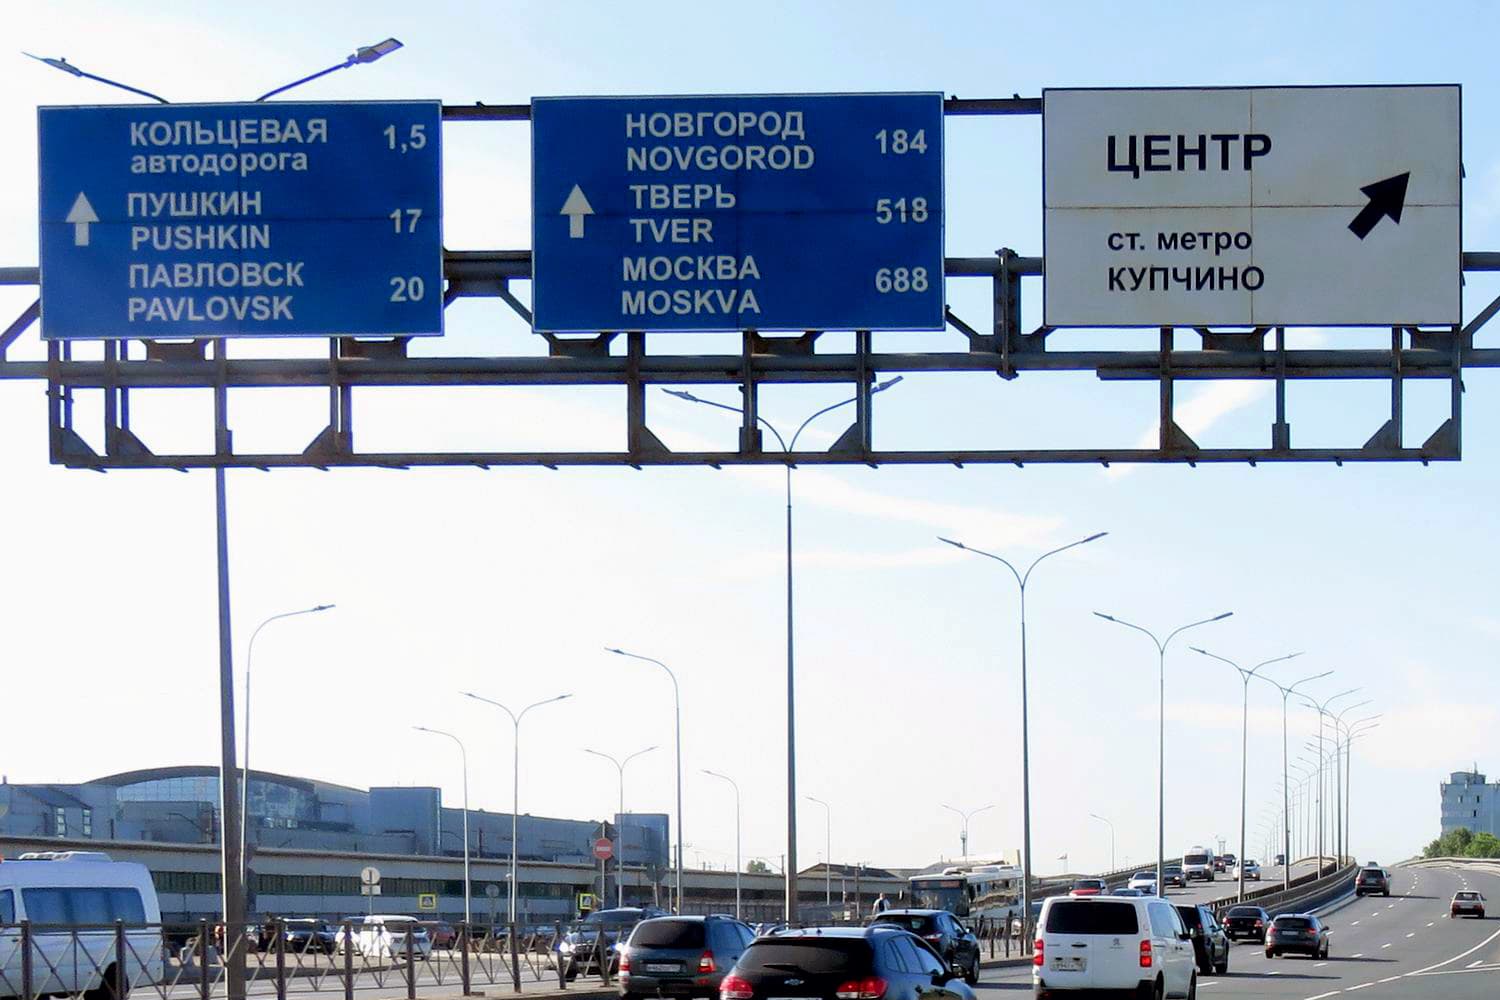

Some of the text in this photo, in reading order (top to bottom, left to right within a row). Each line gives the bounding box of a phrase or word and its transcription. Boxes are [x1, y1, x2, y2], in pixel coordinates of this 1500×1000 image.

[132, 120, 326, 147] КОЛЬЦЕВАЯ
[627, 112, 804, 139] НОВГОРОД
[386, 126, 425, 153] 1,5
[877, 130, 926, 153] 184
[132, 154, 306, 176] автодорога
[628, 146, 813, 170] NOVGOROD
[1108, 134, 1271, 179] ЦЕНТР
[129, 192, 260, 216] ПУШКИН
[631, 185, 735, 208] ТВЕРЬ
[391, 210, 420, 232] 17
[878, 199, 927, 223] 518
[133, 225, 268, 249] PUSHKIN
[631, 220, 711, 242] TVER
[1108, 232, 1252, 256] ст. метро
[130, 263, 303, 288] ПАВЛОВСК
[624, 256, 759, 280] МОСКВА
[876, 268, 927, 292] 688
[1109, 266, 1264, 291] КУПЧИНО
[391, 278, 423, 300] 20
[129, 296, 292, 321] PAVLOVSK
[623, 290, 759, 314] MOSKVA
